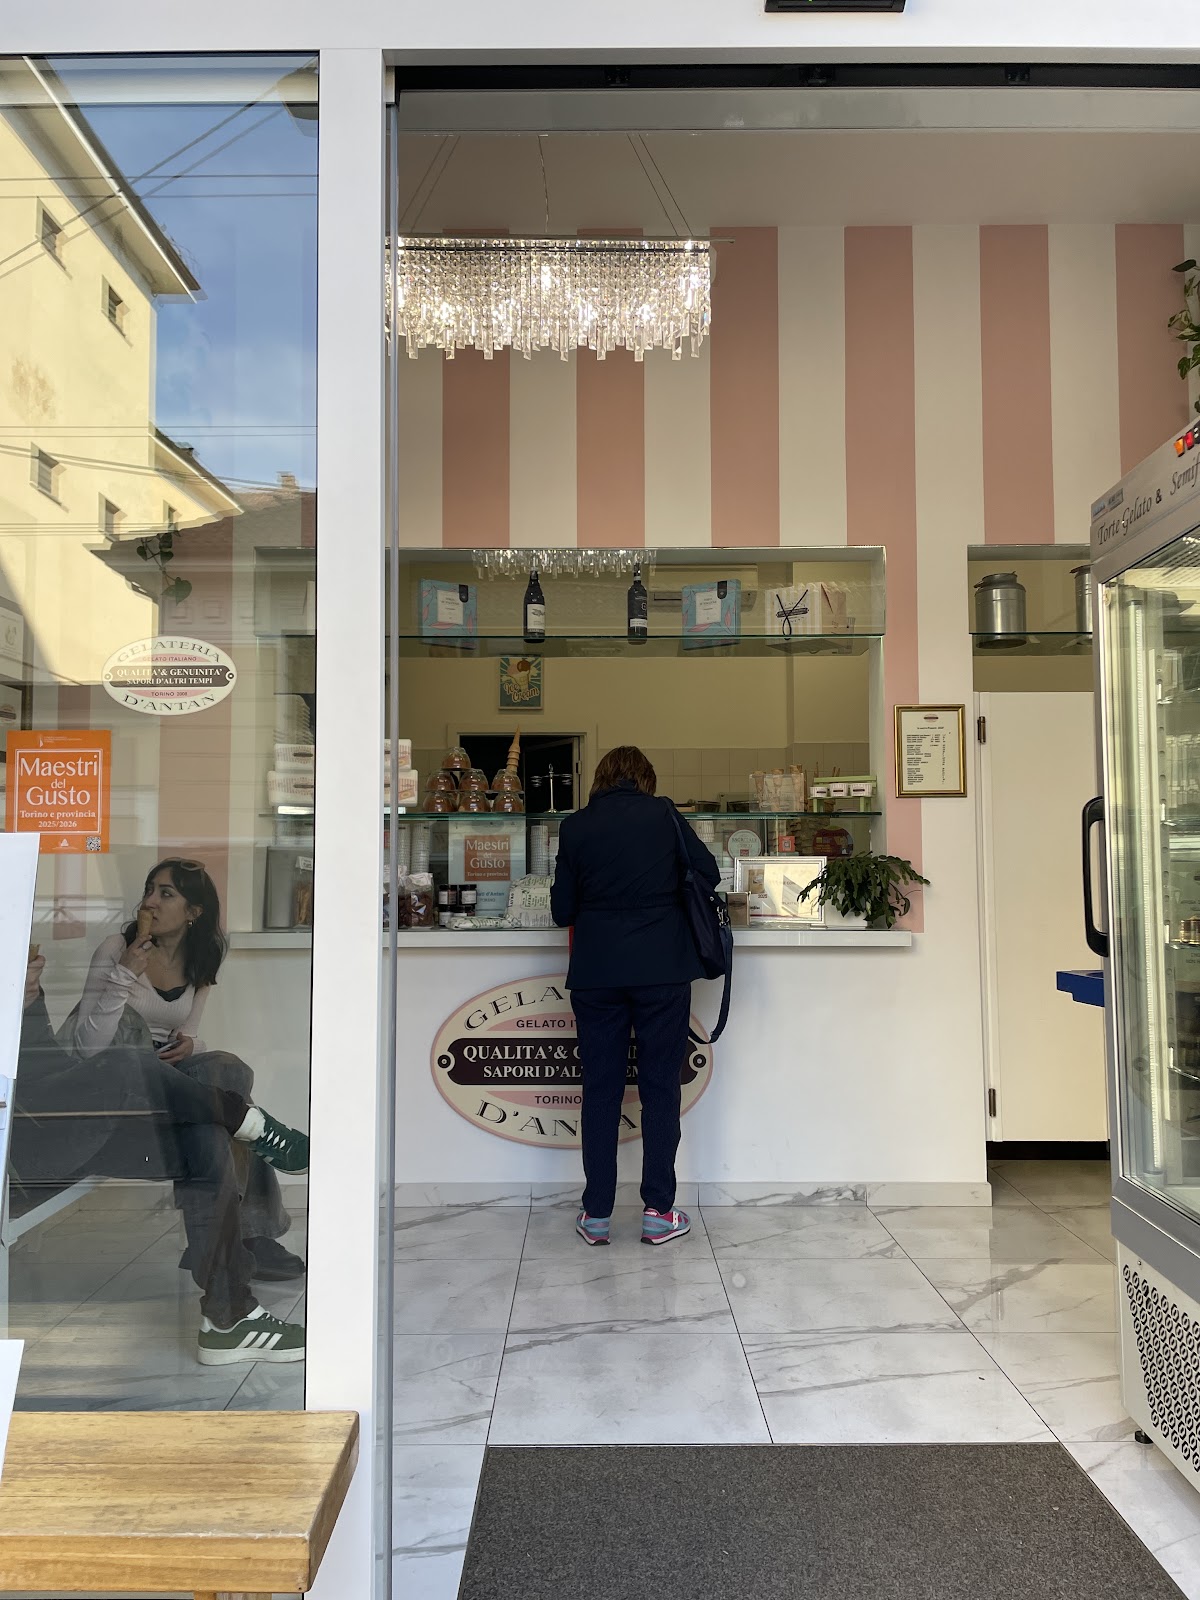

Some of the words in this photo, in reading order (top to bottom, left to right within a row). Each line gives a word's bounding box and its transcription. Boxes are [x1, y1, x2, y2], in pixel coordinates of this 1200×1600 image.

[1098, 519, 1120, 545] Torte
[1122, 496, 1152, 536] Gelato
[1155, 489, 1162, 504] &
[117, 641, 220, 663] GELATERIA
[156, 677, 187, 685] D'ALTRI
[512, 687, 540, 702] Cream
[123, 693, 216, 711] D'ANTAN
[20, 754, 98, 777] Maestri
[50, 778, 66, 789] del
[26, 786, 91, 806] Gusto
[19, 810, 48, 818] Torino
[56, 810, 96, 819] provincia
[38, 820, 78, 828] 2025/2026
[466, 838, 509, 851] Maestri
[470, 856, 505, 869] Gusto
[516, 1019, 566, 1028] GELATO
[483, 1065, 541, 1078] SAPORI
[544, 1065, 583, 1078] D'AL
[534, 1095, 582, 1105] TORINO
